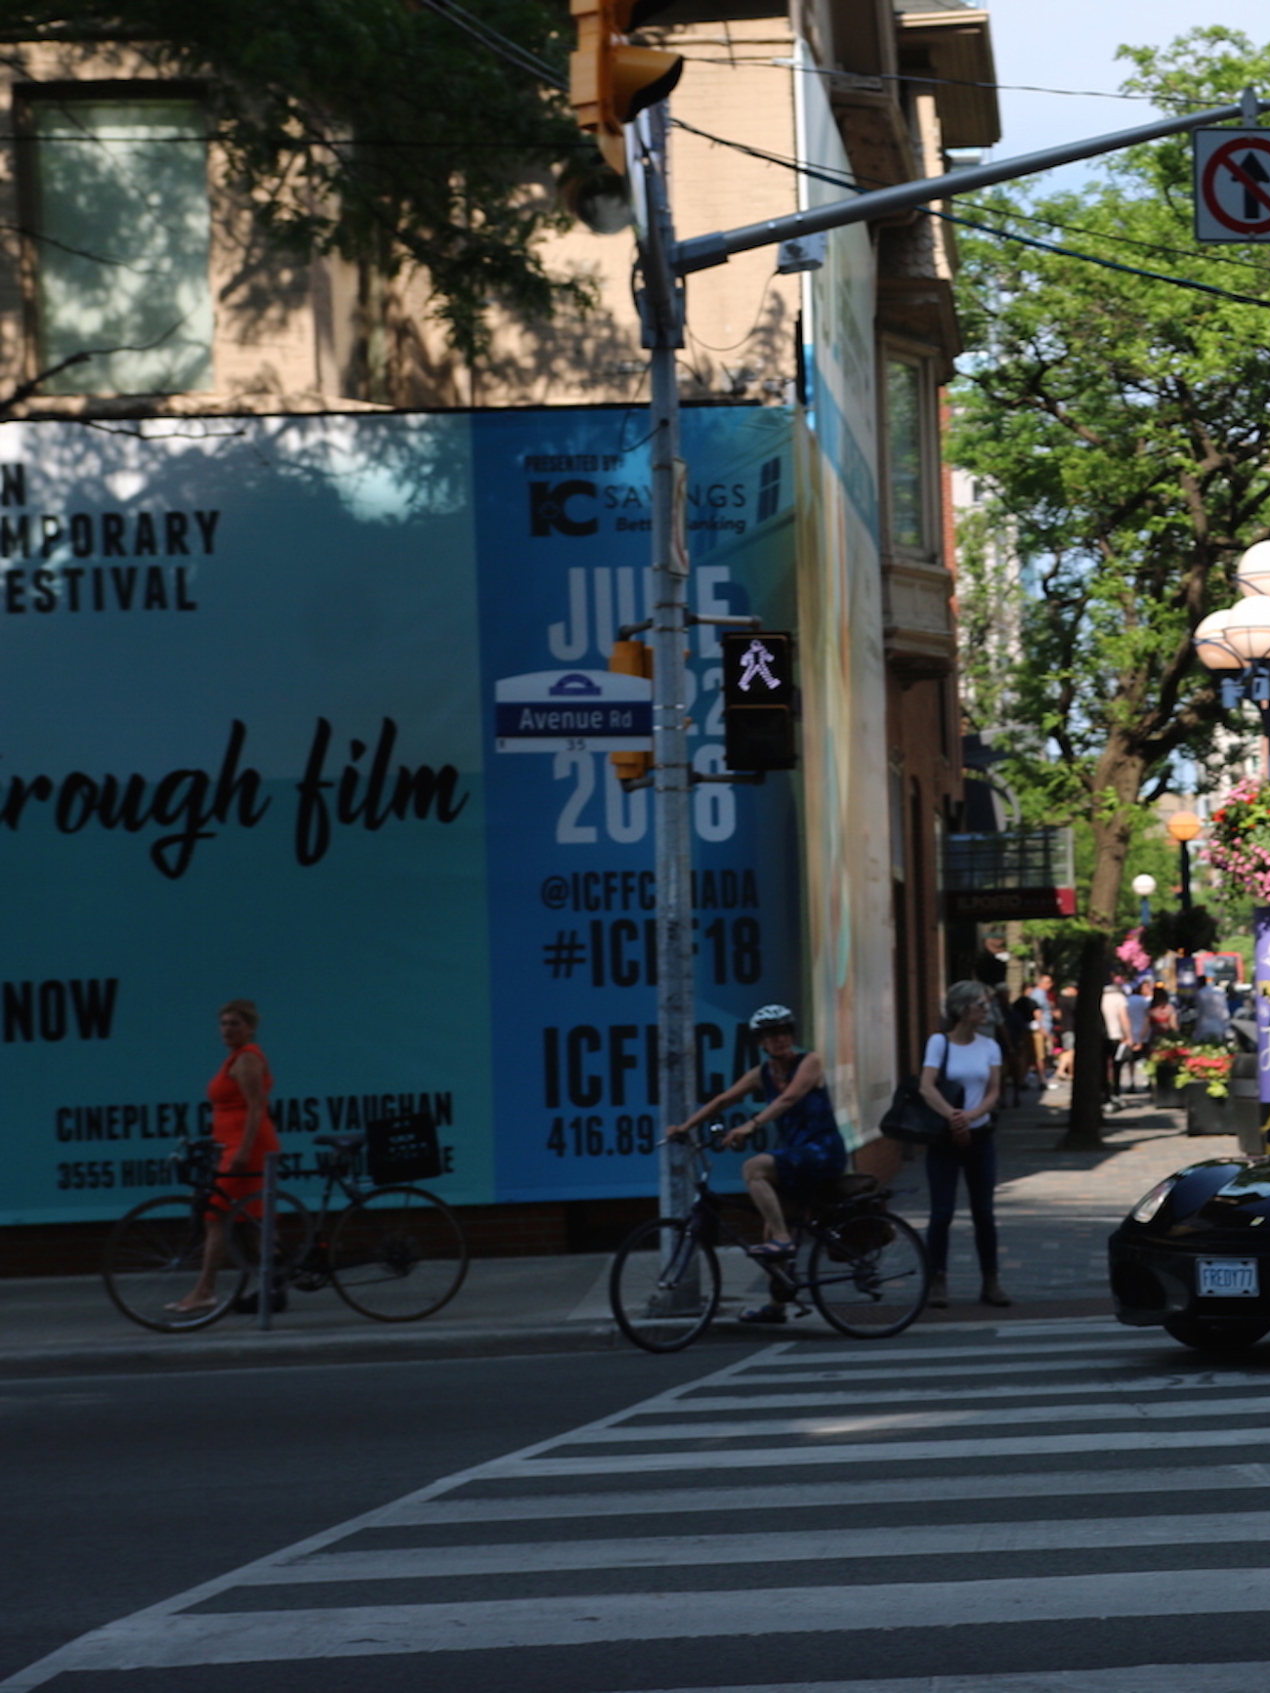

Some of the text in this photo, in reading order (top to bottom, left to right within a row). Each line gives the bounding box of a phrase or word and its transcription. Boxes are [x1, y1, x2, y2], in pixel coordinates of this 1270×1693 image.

[525, 455, 598, 472] PRESENTED
[0, 511, 220, 559] MPORARY
[687, 515, 746, 534] anking
[5, 565, 198, 614] ESTIVAL
[548, 566, 731, 661] JUE
[518, 707, 633, 731] Avenue Rd
[566, 738, 587, 750] 35
[0, 716, 471, 880] rough film
[553, 743, 737, 843] 208
[3, 977, 119, 1043] NOW
[56, 1102, 189, 1143] CINEPLEX
[57, 1160, 116, 1190] 3555
